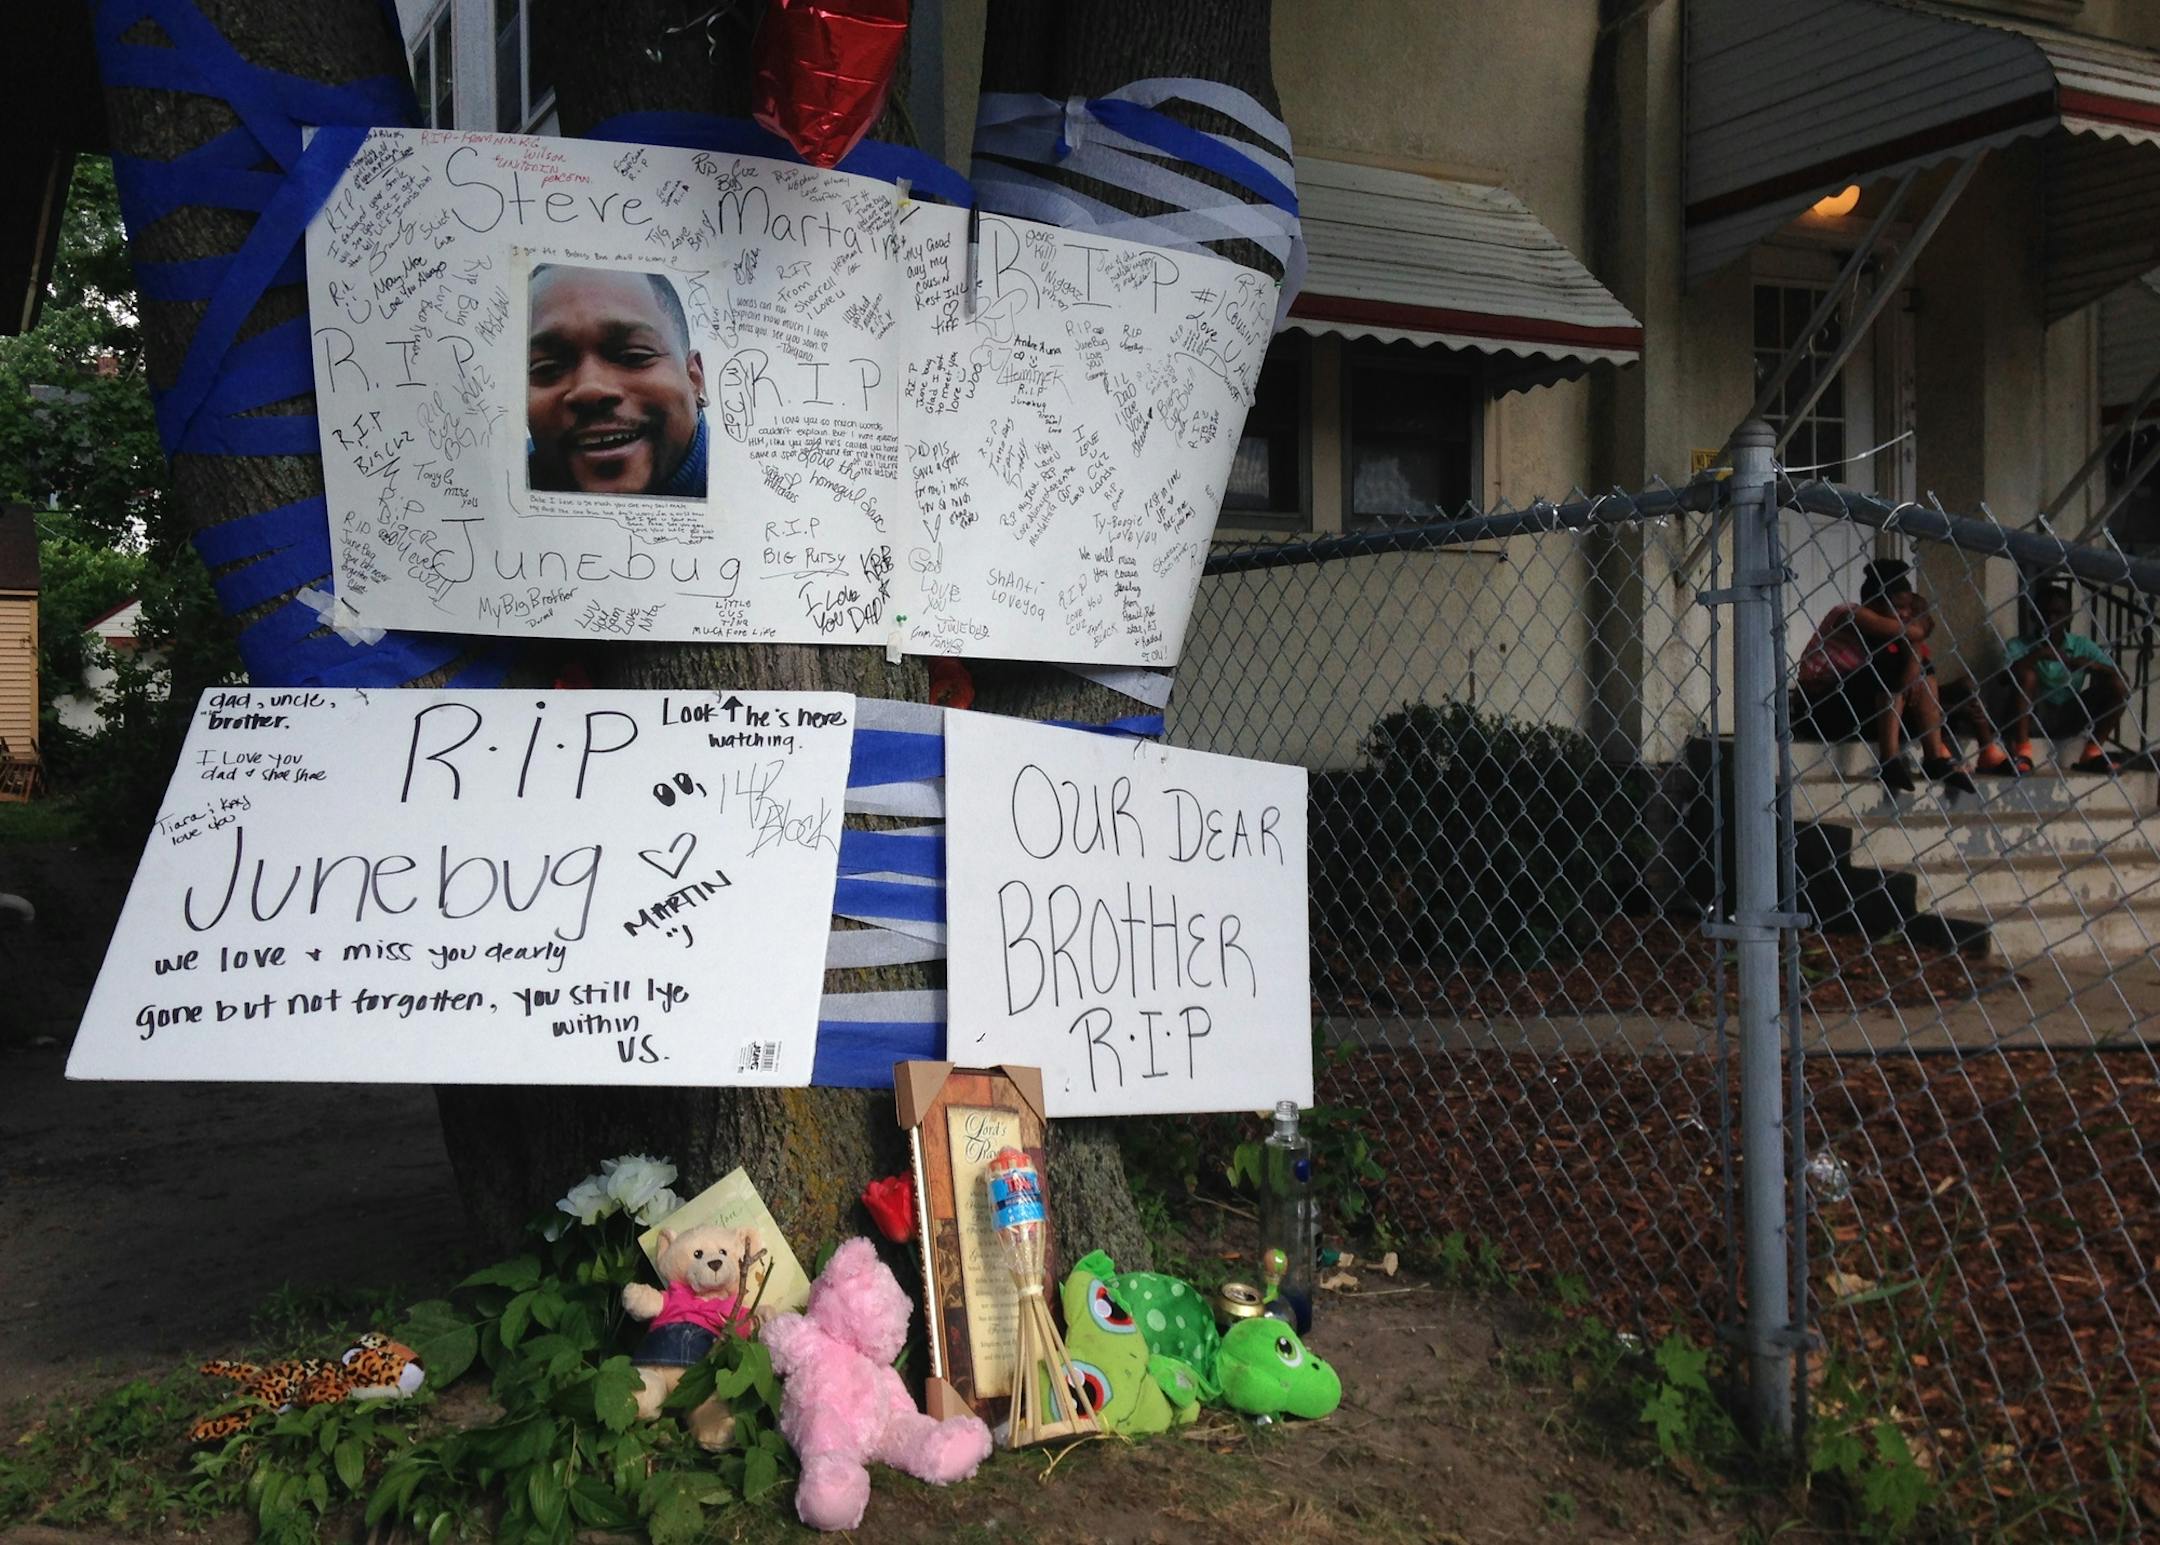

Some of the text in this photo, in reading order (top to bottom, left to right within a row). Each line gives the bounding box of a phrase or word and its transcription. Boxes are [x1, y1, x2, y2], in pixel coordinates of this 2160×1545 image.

[446, 146, 653, 233] Steve
[777, 280, 813, 305] From
[526, 585, 579, 611] Brother
[847, 597, 884, 635] DAD
[661, 697, 849, 730] Look he's here
[196, 749, 304, 772] I Love you
[200, 766, 238, 782] dad
[746, 797, 841, 860] Block
[1012, 764, 1285, 867] OUR DEAR
[171, 828, 204, 847] love
[184, 826, 604, 943] Junebug
[622, 868, 734, 940] MARTIN
[154, 940, 569, 976] we love miss you dearly
[998, 879, 1258, 1017] BROTHER
[135, 1000, 204, 1042] gone
[215, 993, 279, 1023] but
[286, 987, 344, 1017] not
[511, 986, 562, 1018] you
[568, 977, 632, 1007] still
[646, 977, 691, 1015] lye
[551, 1013, 641, 1038] within
